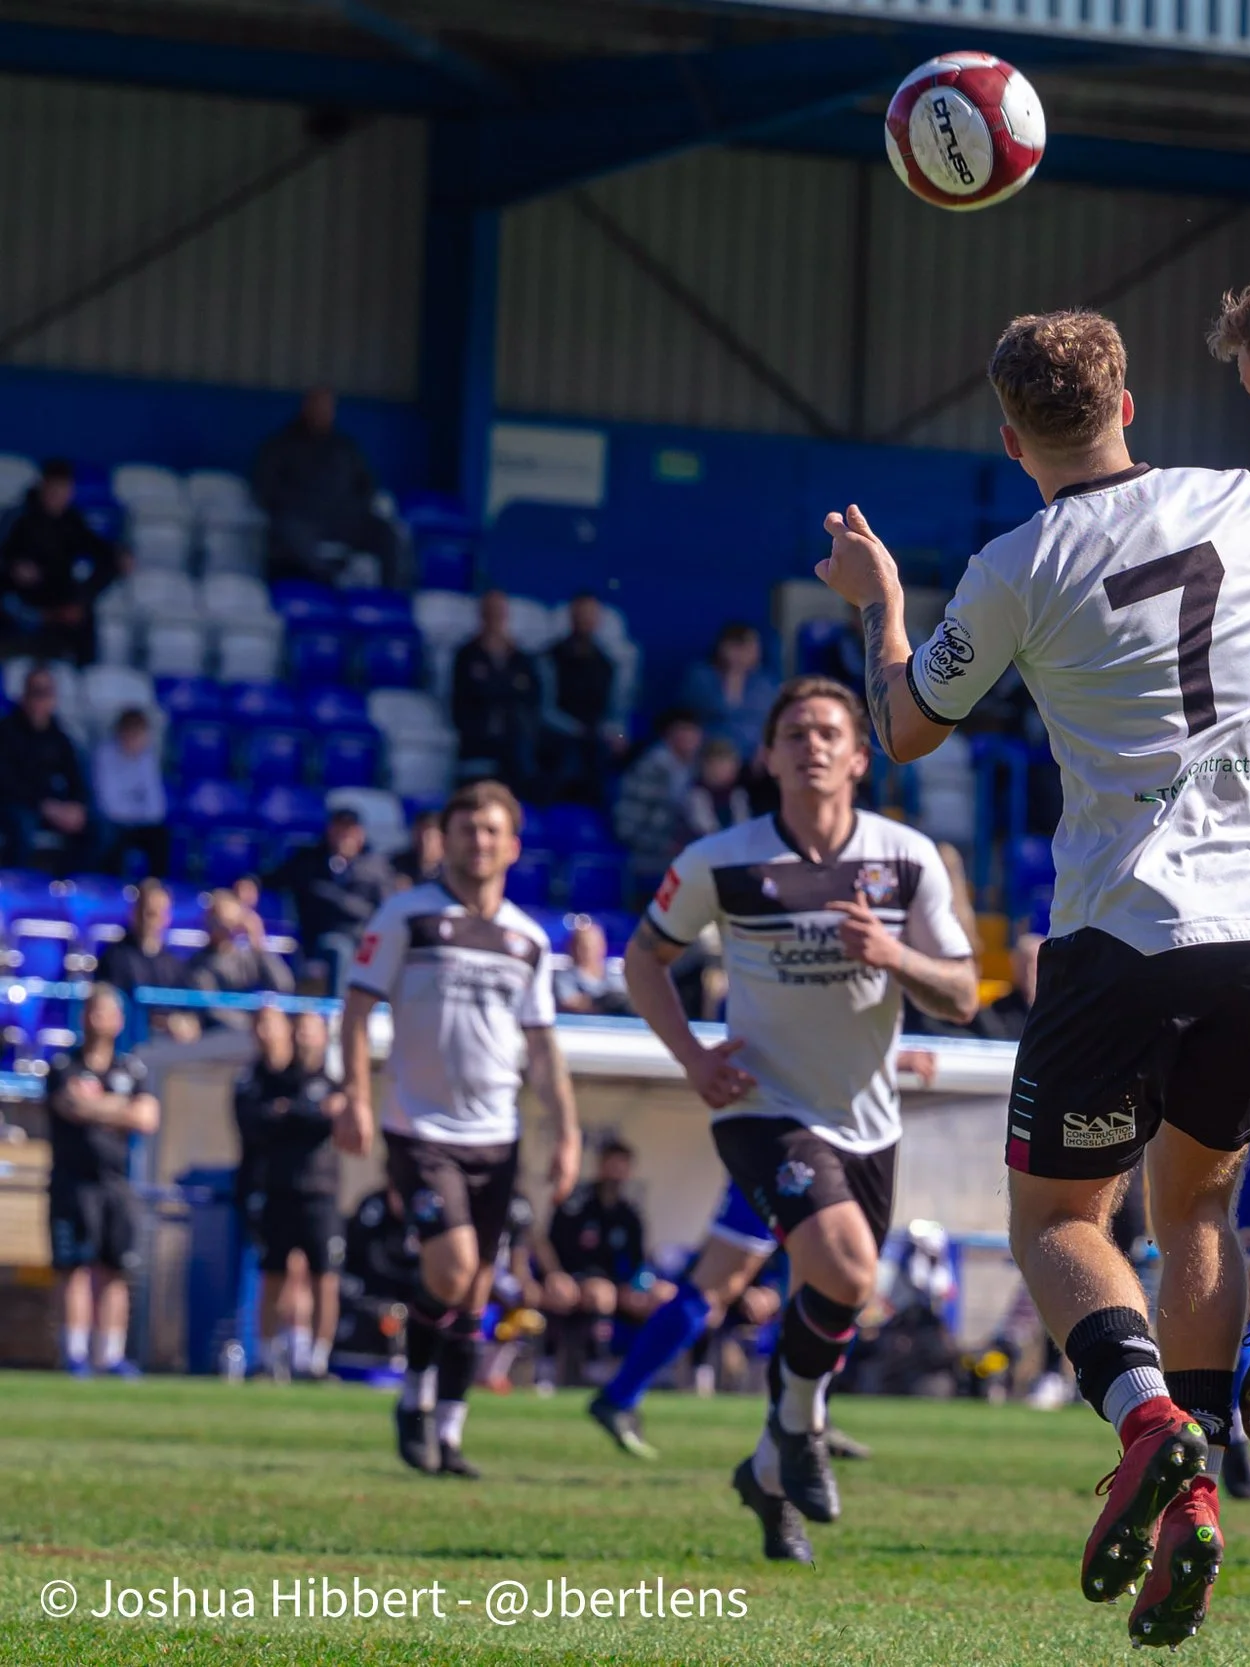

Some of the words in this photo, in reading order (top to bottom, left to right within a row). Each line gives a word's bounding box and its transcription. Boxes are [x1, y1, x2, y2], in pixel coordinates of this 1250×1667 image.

[1103, 540, 1225, 738] 7
[1064, 1106, 1137, 1131] SAN
[1066, 1125, 1134, 1140] CONSTRUCTION
[1118, 1131, 1134, 1141] LTD
